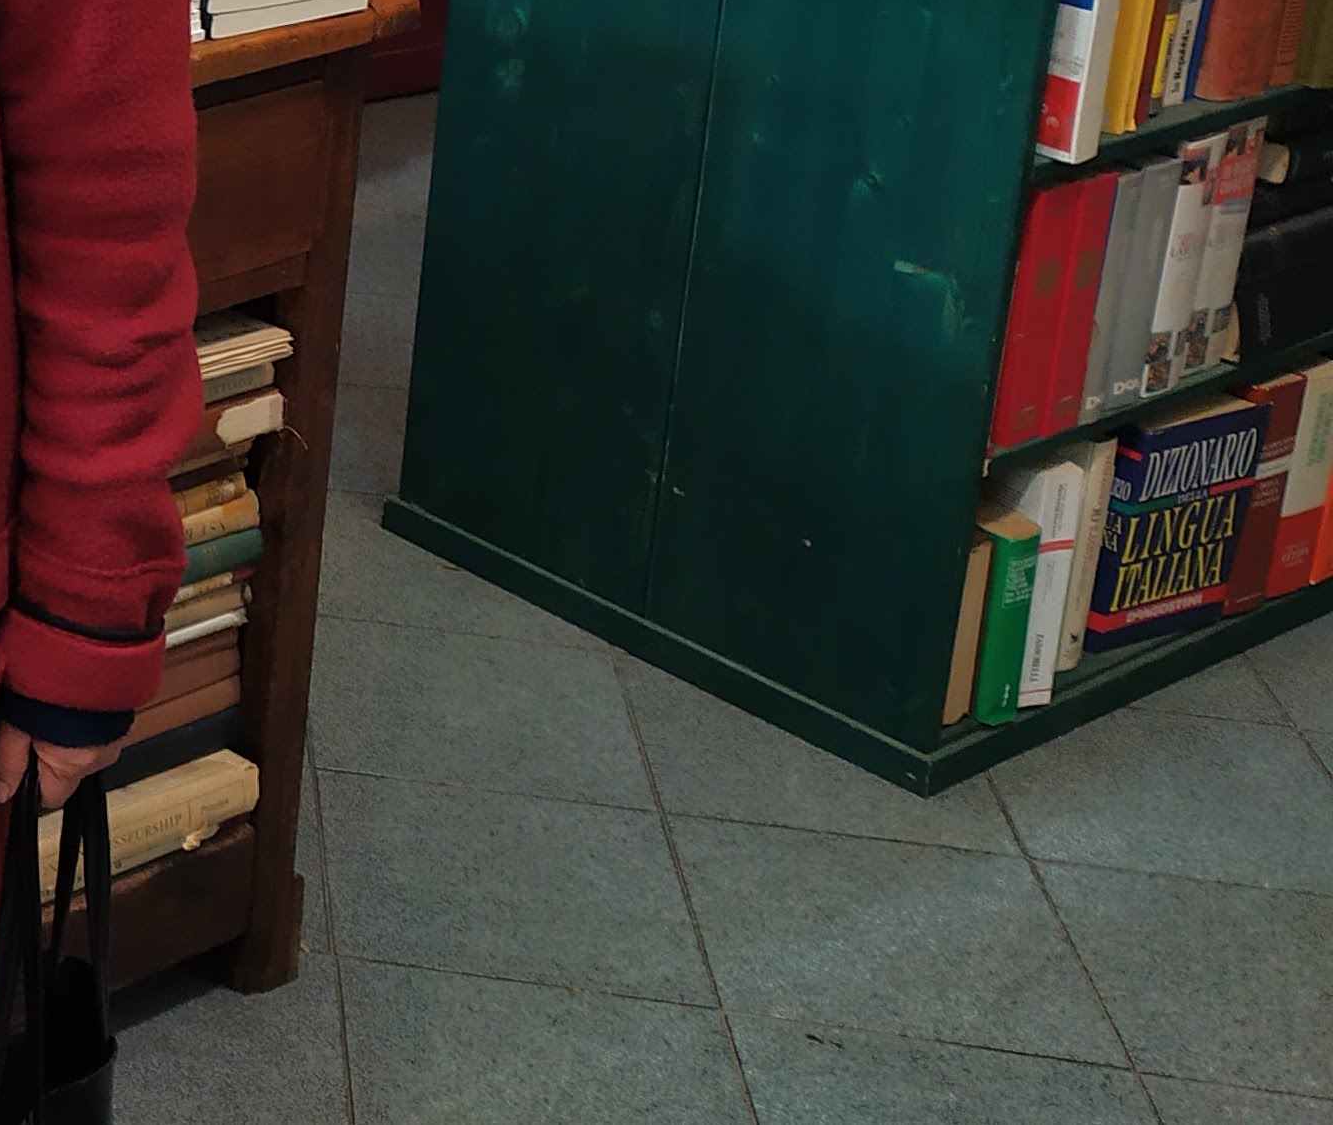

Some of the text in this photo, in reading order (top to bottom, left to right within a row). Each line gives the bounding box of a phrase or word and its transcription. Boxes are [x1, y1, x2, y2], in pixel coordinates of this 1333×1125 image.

[1139, 427, 1258, 503] DIZIONARIO
[1121, 491, 1237, 565] LINGUA
[1109, 541, 1225, 613] ITALIANA
